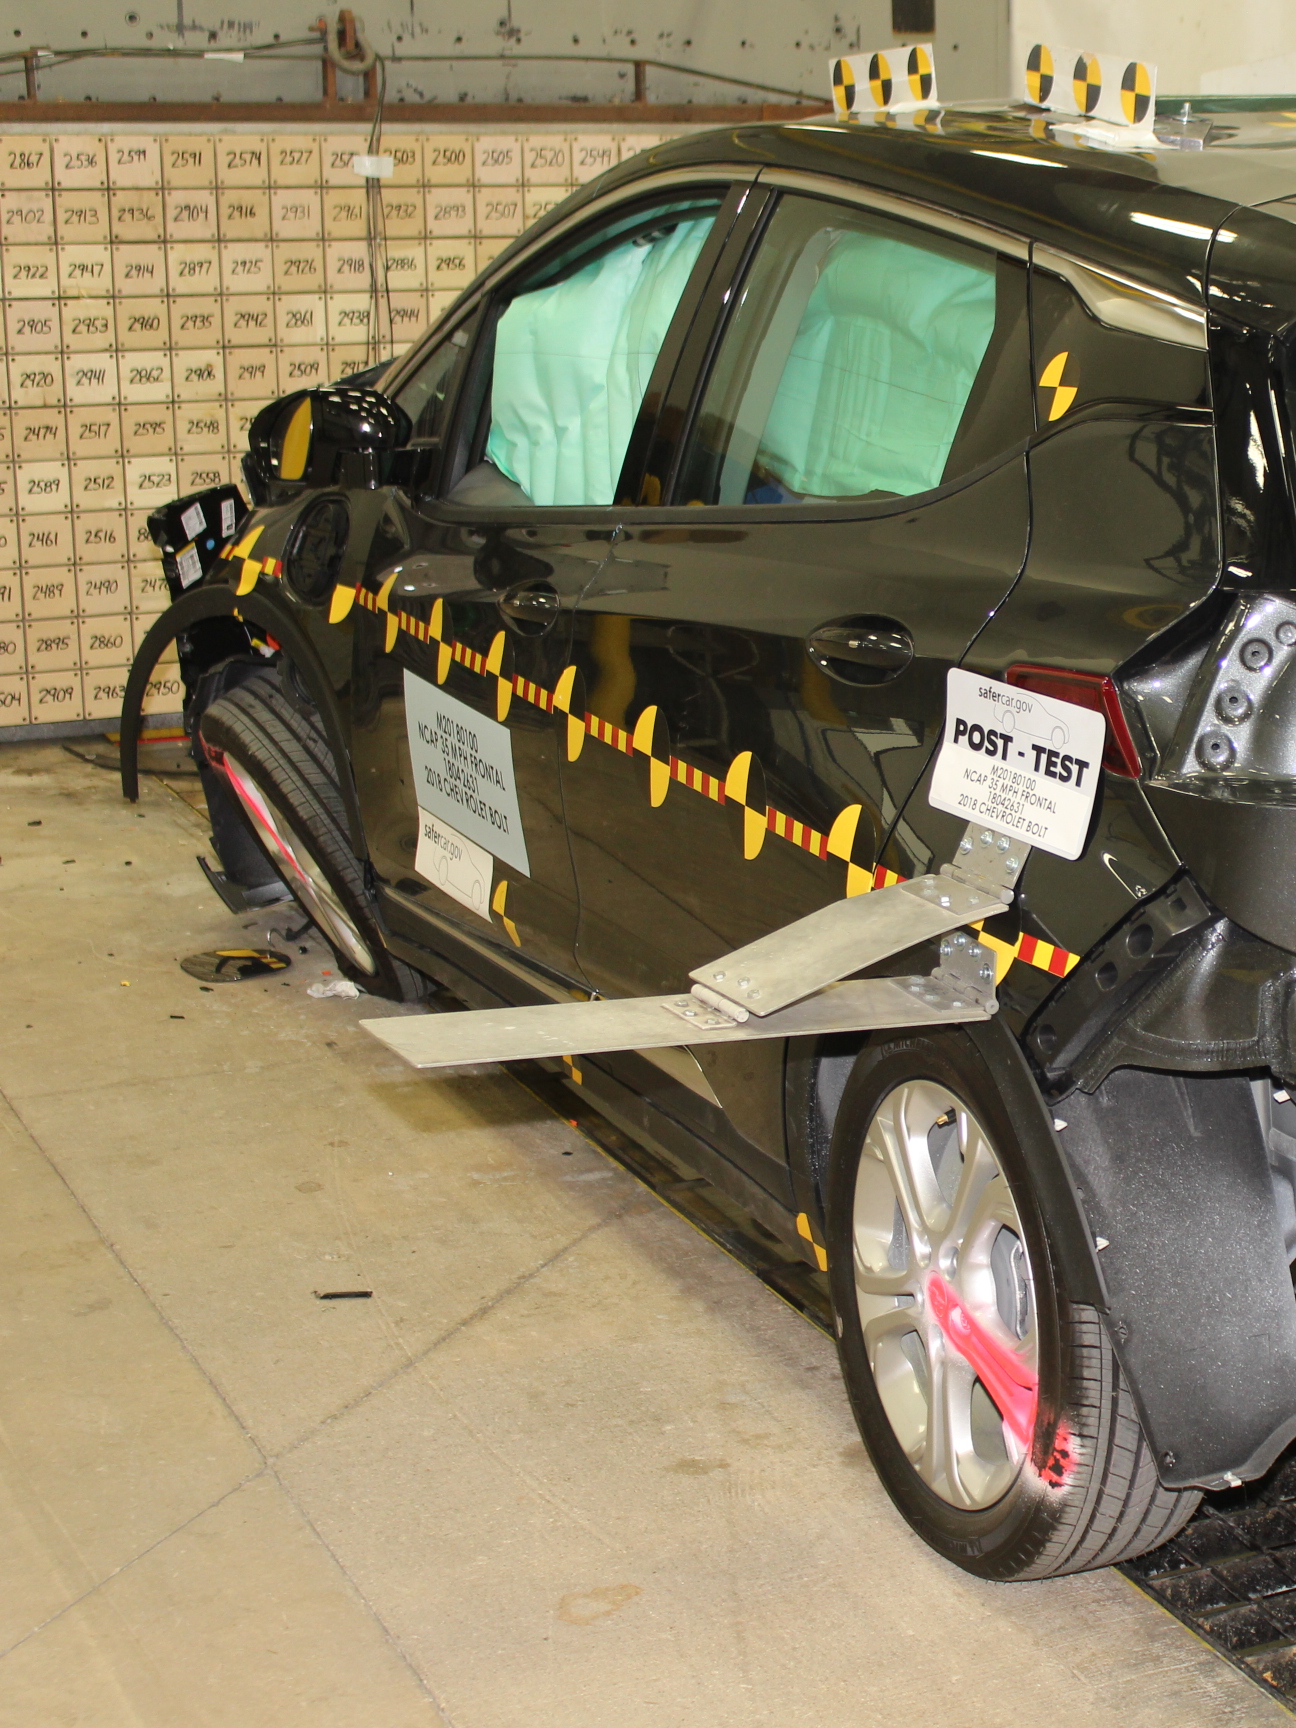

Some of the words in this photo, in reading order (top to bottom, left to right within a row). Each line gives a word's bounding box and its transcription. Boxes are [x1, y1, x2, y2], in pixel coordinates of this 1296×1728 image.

[8, 152, 43, 169] 2867
[63, 152, 98, 170] 2536
[171, 151, 202, 169] 2591
[226, 151, 262, 169] 2574
[330, 151, 360, 169] 257
[432, 147, 466, 166] 2500
[482, 149, 513, 167] 2505
[530, 148, 565, 168] 2520
[6, 208, 46, 225] 2902
[64, 208, 99, 225] 2913
[118, 207, 155, 222] 2936
[173, 204, 208, 222] 2904
[227, 204, 256, 221] 2916
[281, 204, 310, 221] 2931
[333, 204, 362, 222] 2961
[385, 204, 417, 219] 2932
[434, 204, 466, 221] 2893
[485, 202, 518, 220] 2507
[13, 264, 48, 280] 2922
[68, 263, 104, 279] 2947
[124, 263, 154, 279] 2914
[178, 261, 212, 277] 2897
[284, 258, 316, 276] 2926
[337, 257, 365, 274] 2918
[436, 256, 466, 271] 2956
[128, 315, 160, 332] 2960
[180, 314, 215, 331] 2935
[233, 312, 267, 328] 2942
[286, 310, 313, 328] 2861
[338, 310, 370, 327] 2938
[390, 308, 420, 324] 2944
[16, 318, 52, 335] 2905
[71, 317, 108, 335] 2953
[76, 369, 106, 386] 2941
[129, 367, 163, 385] 2862
[238, 364, 266, 380] 2919
[289, 361, 320, 378] 2509
[20, 372, 54, 388] 2920
[23, 425, 58, 442] 2474
[79, 422, 111, 440] 2517
[134, 421, 166, 436] 2595
[187, 420, 220, 435] 2548
[28, 479, 60, 495] 2589
[84, 476, 115, 492] 2512
[138, 473, 172, 490] 2523
[190, 471, 221, 487] 2558
[28, 532, 58, 548] 2461
[85, 530, 116, 545] 2516
[33, 583, 64, 601] 2489
[86, 580, 118, 596] 2490
[37, 637, 71, 653] 2895
[90, 635, 123, 651] 2860
[39, 686, 74, 704] 2909
[978, 685, 1034, 714] safercar.gov
[436, 711, 479, 754] M20180100
[418, 720, 439, 749] NCAP
[440, 735, 450, 757] 35
[451, 741, 469, 769] MPH
[469, 753, 506, 792] FRONTAL
[953, 717, 1013, 762] POST
[1031, 743, 1090, 788] TEST
[444, 757, 480, 796] 18042631
[990, 764, 1037, 791] M20180100
[963, 768, 988, 786] NCAP
[988, 777, 1000, 791] 35
[1000, 782, 1020, 799] MPH
[1020, 790, 1057, 814] FRONTAL
[424, 765, 443, 792] 2018
[443, 778, 488, 821] CHEVROLET
[489, 805, 509, 835] BOLT
[987, 790, 1025, 815] 18042631
[958, 793, 978, 811] 2018
[978, 802, 1026, 830] CHEVROLET
[1026, 821, 1048, 838] BOLT
[424, 823, 463, 861] safercar.gov
